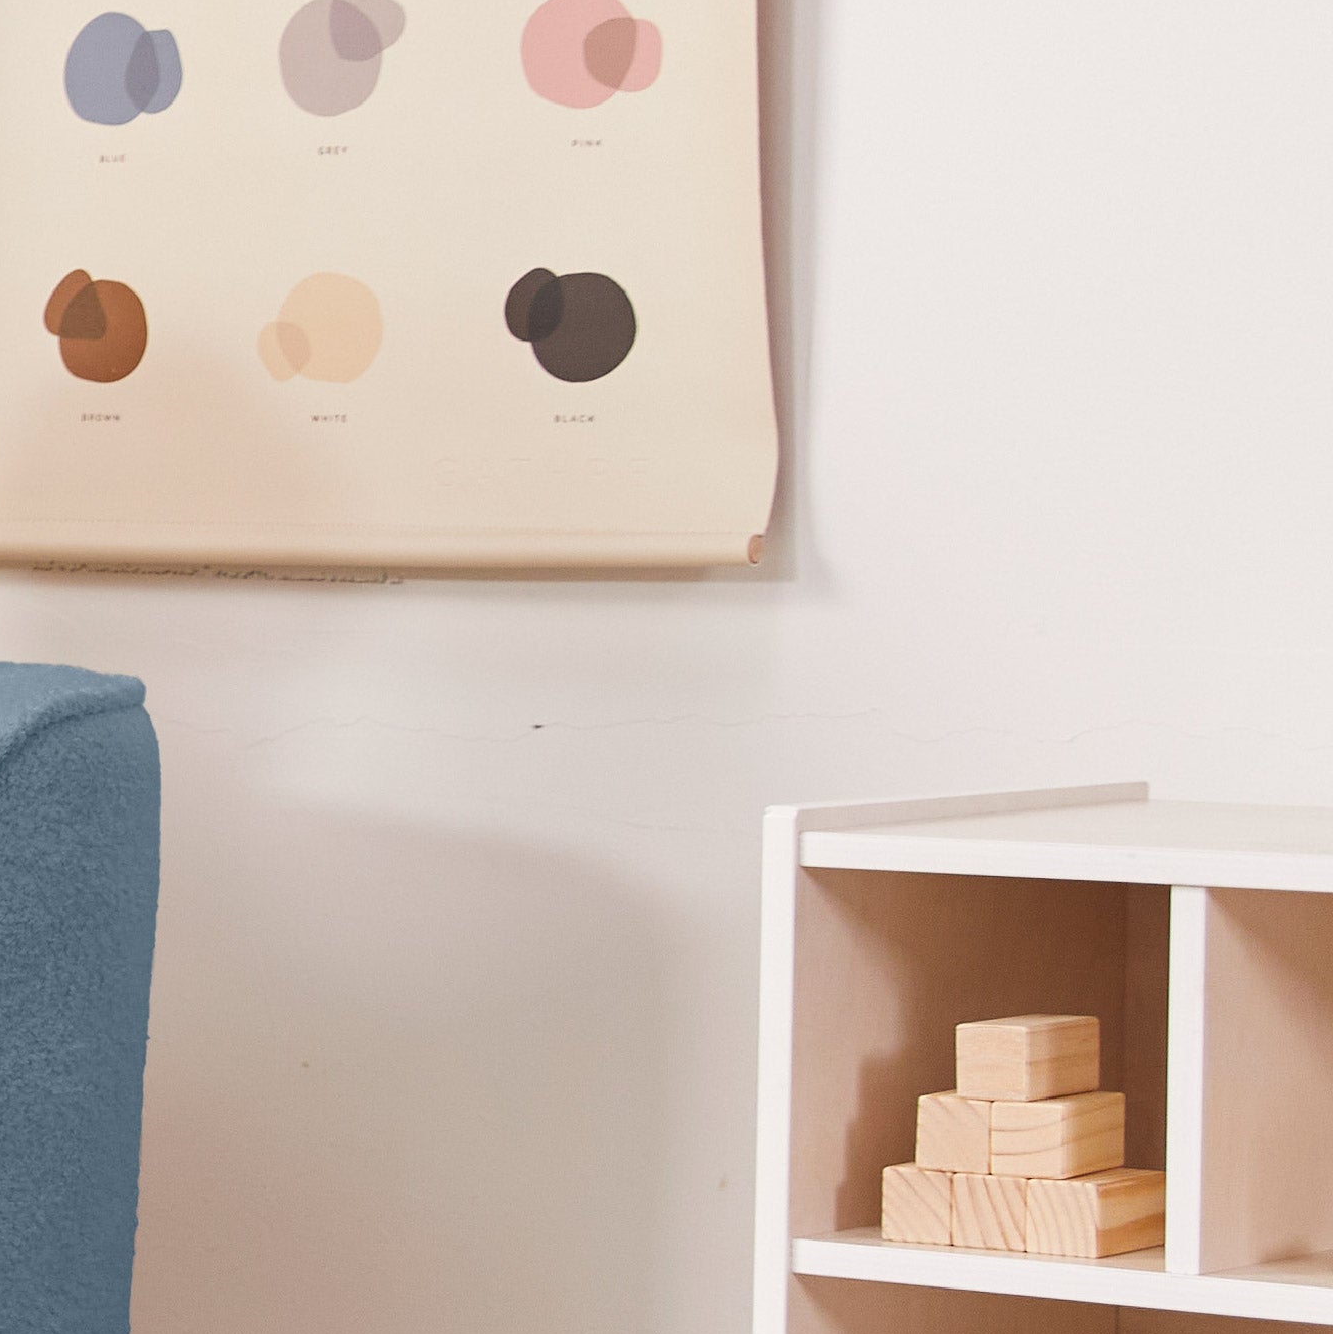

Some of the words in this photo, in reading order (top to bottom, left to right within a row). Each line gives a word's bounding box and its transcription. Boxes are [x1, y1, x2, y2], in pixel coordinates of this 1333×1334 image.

[571, 138, 603, 148] PINK
[99, 154, 126, 164] BLUE
[80, 413, 121, 423] BROWN
[310, 413, 348, 424] WHITE
[553, 413, 595, 424] BLACK
